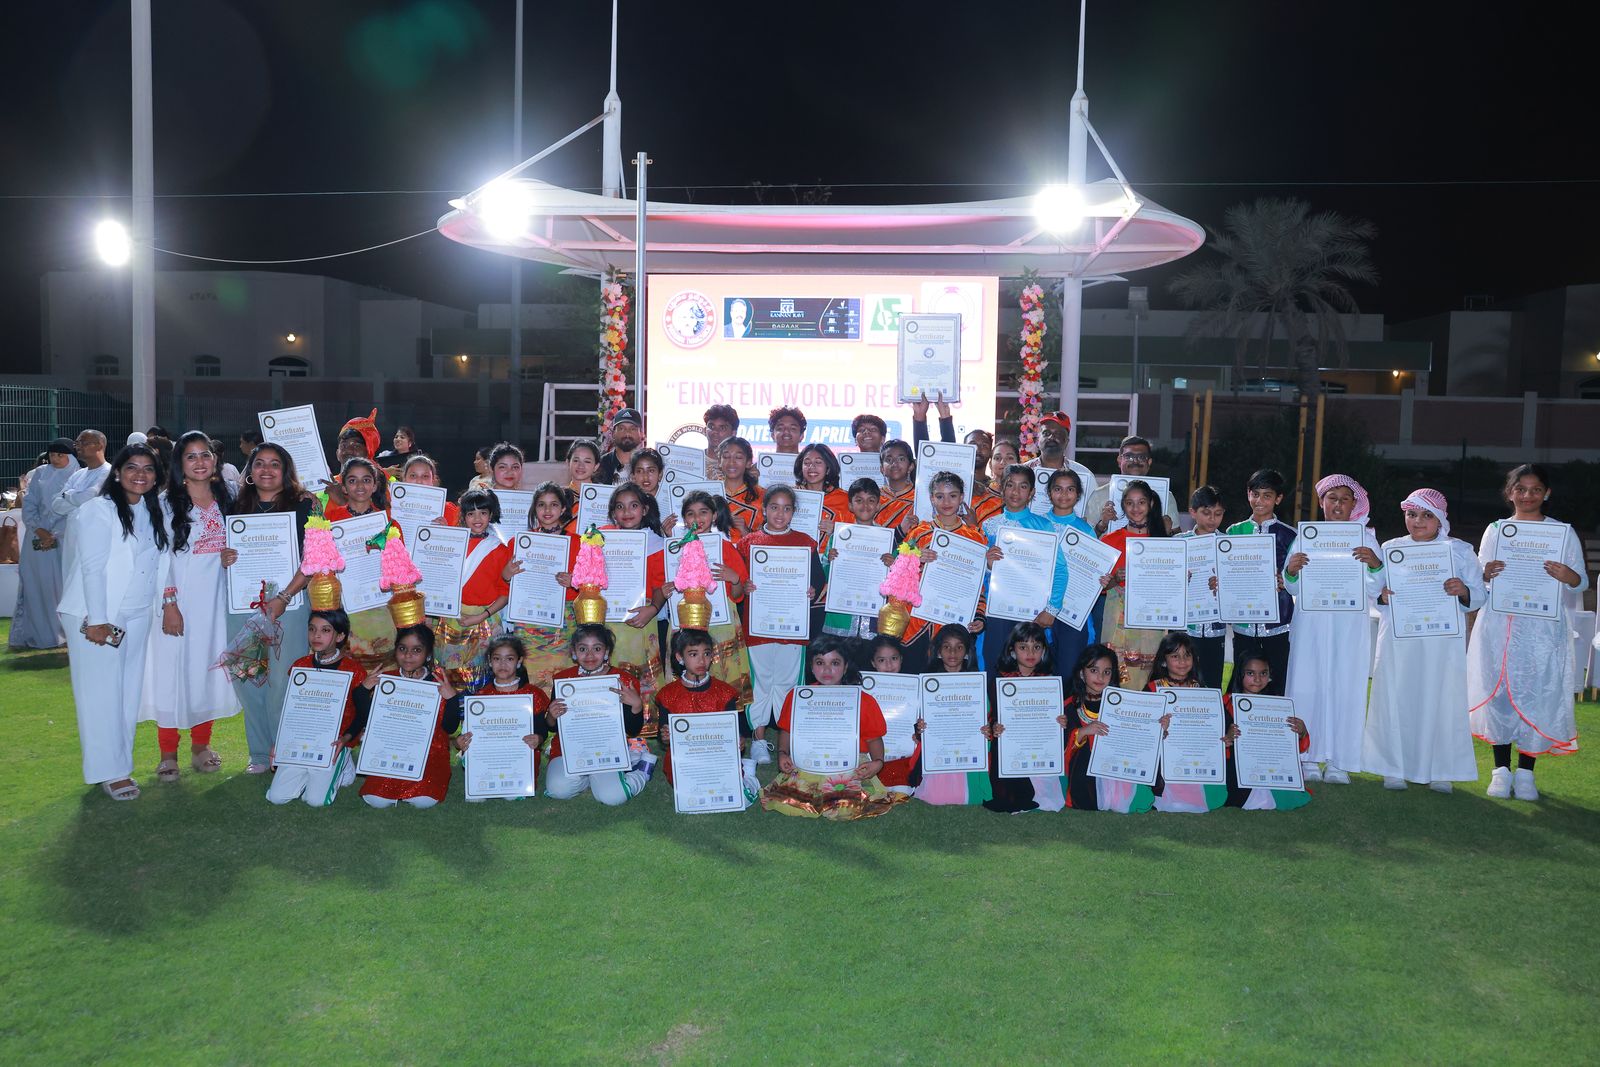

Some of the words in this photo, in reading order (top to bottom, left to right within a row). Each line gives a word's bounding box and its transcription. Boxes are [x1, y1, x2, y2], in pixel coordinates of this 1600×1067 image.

[781, 382, 856, 408] WORLD
[273, 426, 305, 436] Certificate
[809, 426, 851, 443] APRIL
[240, 533, 279, 542] Certificate
[424, 543, 456, 553] Certificate
[1312, 541, 1351, 549] Certificate
[1509, 539, 1550, 549] Certificate
[525, 551, 556, 561] Certificate
[1139, 556, 1176, 565] Certificate
[1227, 553, 1263, 561] Certificate
[763, 566, 798, 574] Certificate
[298, 687, 334, 698] Certificate
[934, 693, 973, 702] Certificate
[387, 697, 425, 710] Certificate
[807, 699, 847, 707] Certificate
[1011, 698, 1049, 707] Certificate
[1114, 707, 1152, 719] Certificate
[1173, 705, 1210, 714] Certificate
[479, 717, 519, 725] Certificate
[1248, 713, 1284, 723] Certificate
[685, 733, 725, 742] Certificate
